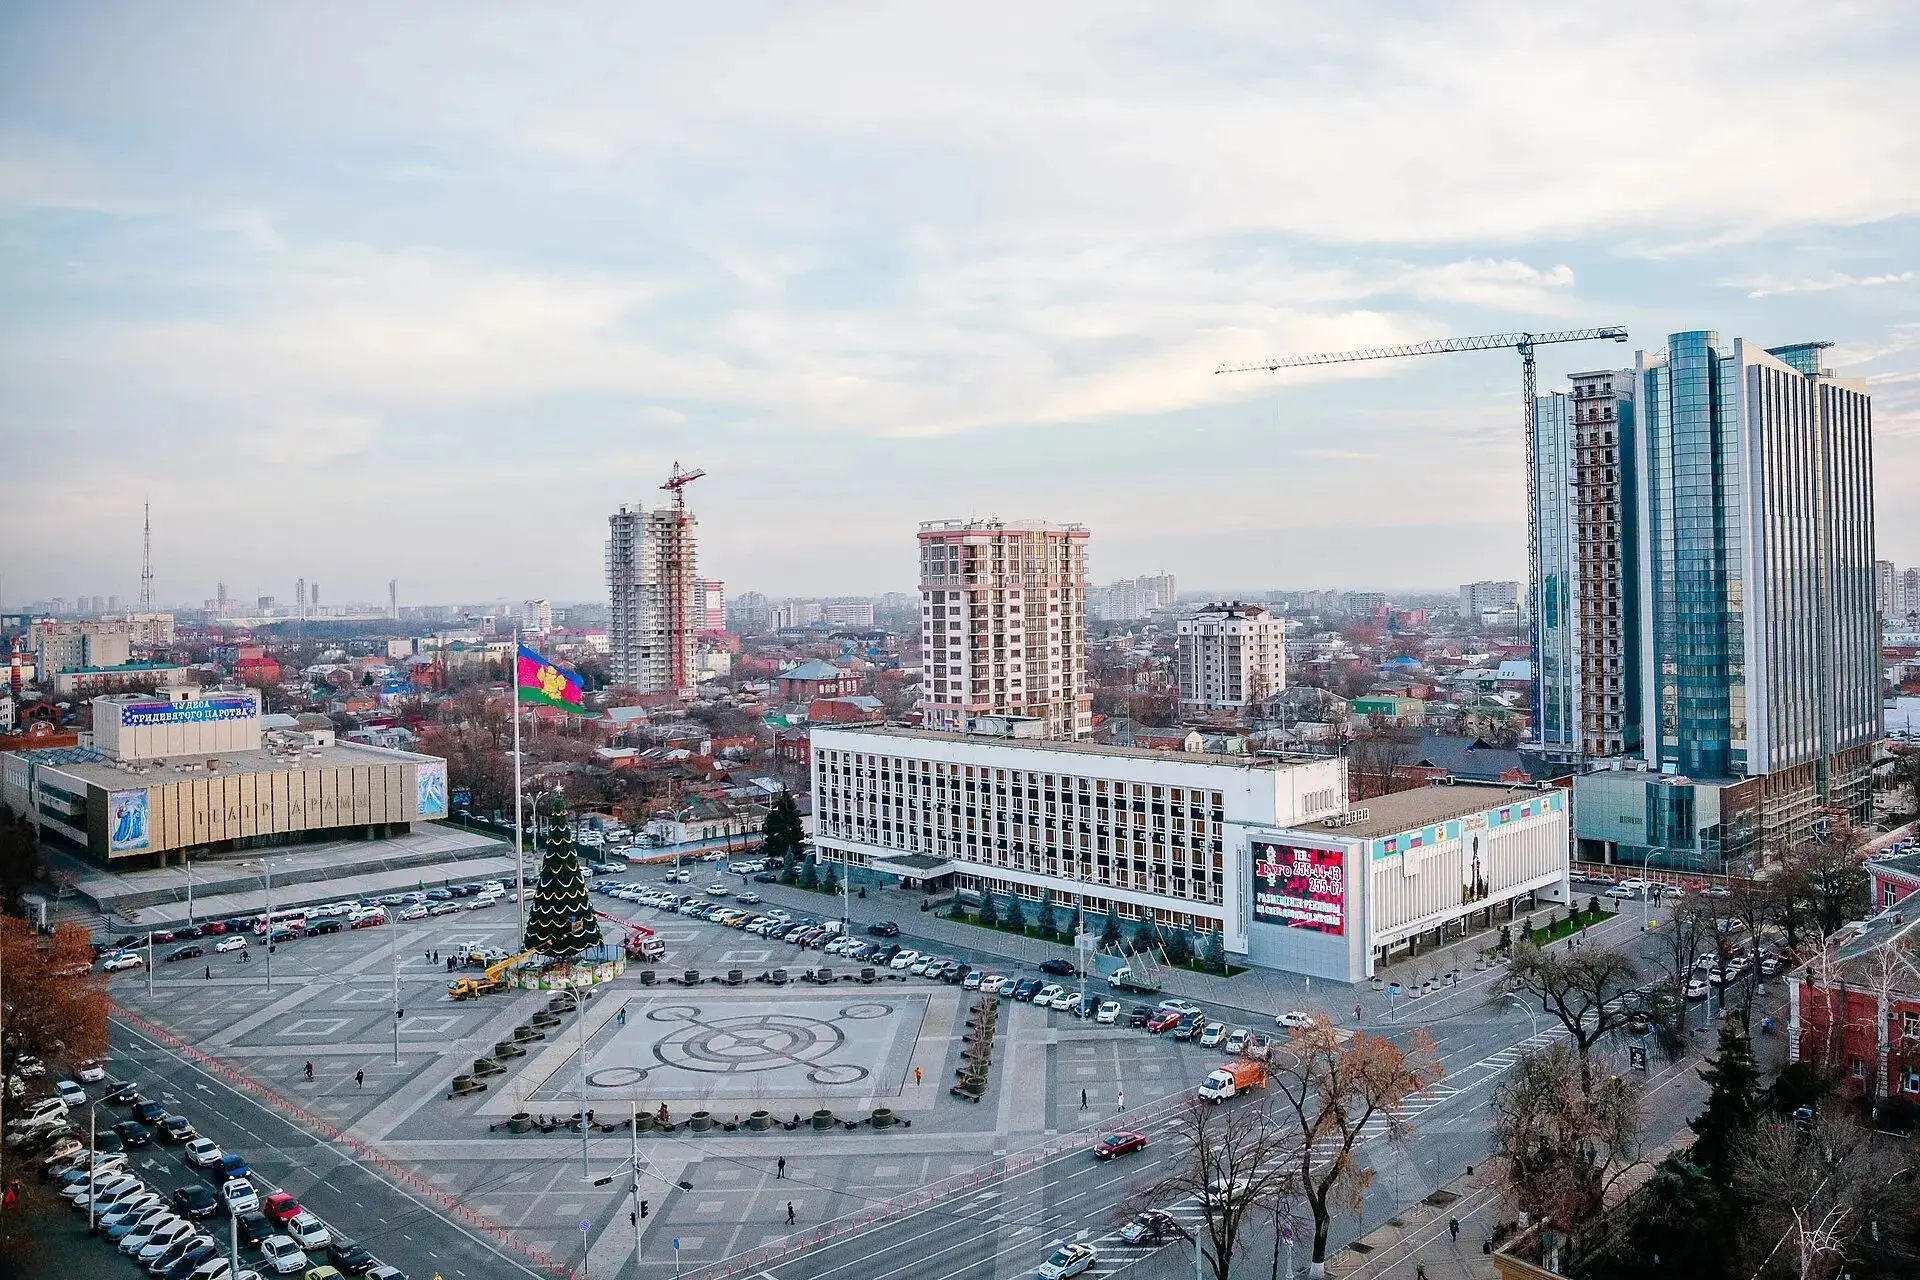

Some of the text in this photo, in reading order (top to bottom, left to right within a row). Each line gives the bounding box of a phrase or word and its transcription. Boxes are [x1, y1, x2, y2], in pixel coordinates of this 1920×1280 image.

[171, 701, 210, 710] ЧУДЕСА
[131, 707, 248, 723] ТРИДЕВЯТОГО ЦАРСТВА
[198, 803, 269, 825] ТЕАТР
[1293, 861, 1341, 881] 255-44-43
[1257, 893, 1303, 908] РАЗМЕЩЕНИЕ
